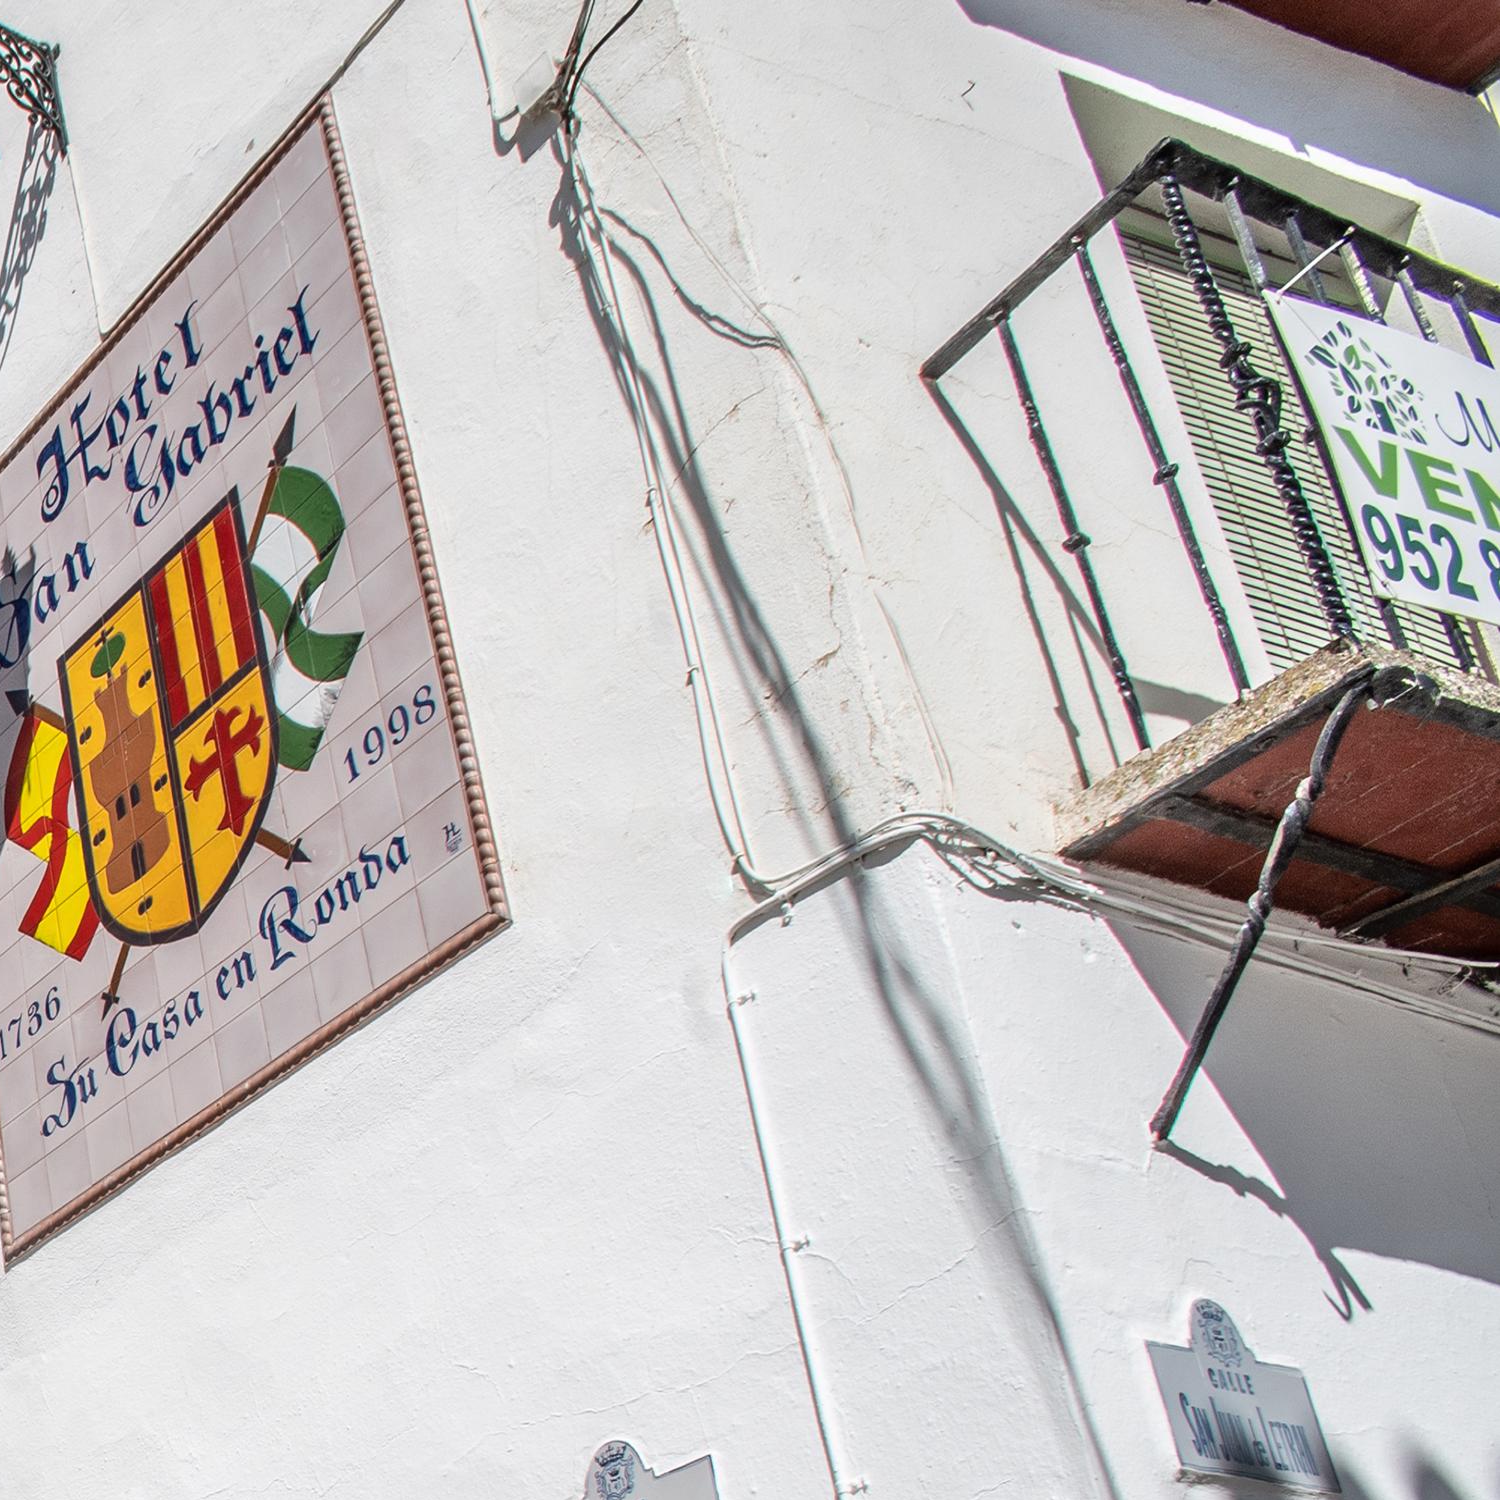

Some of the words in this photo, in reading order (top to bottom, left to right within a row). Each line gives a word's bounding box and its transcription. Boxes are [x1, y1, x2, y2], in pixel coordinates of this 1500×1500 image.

[37, 300, 204, 523] Hotel
[125, 284, 320, 527] Gabriel
[1361, 504, 1479, 602] 952
[343, 684, 437, 784] 1998
[41, 1055, 97, 1138] Su
[105, 990, 204, 1077] Casa
[215, 952, 256, 1000] en
[258, 835, 411, 971] Ronda
[1207, 1367, 1255, 1396] CALLE
